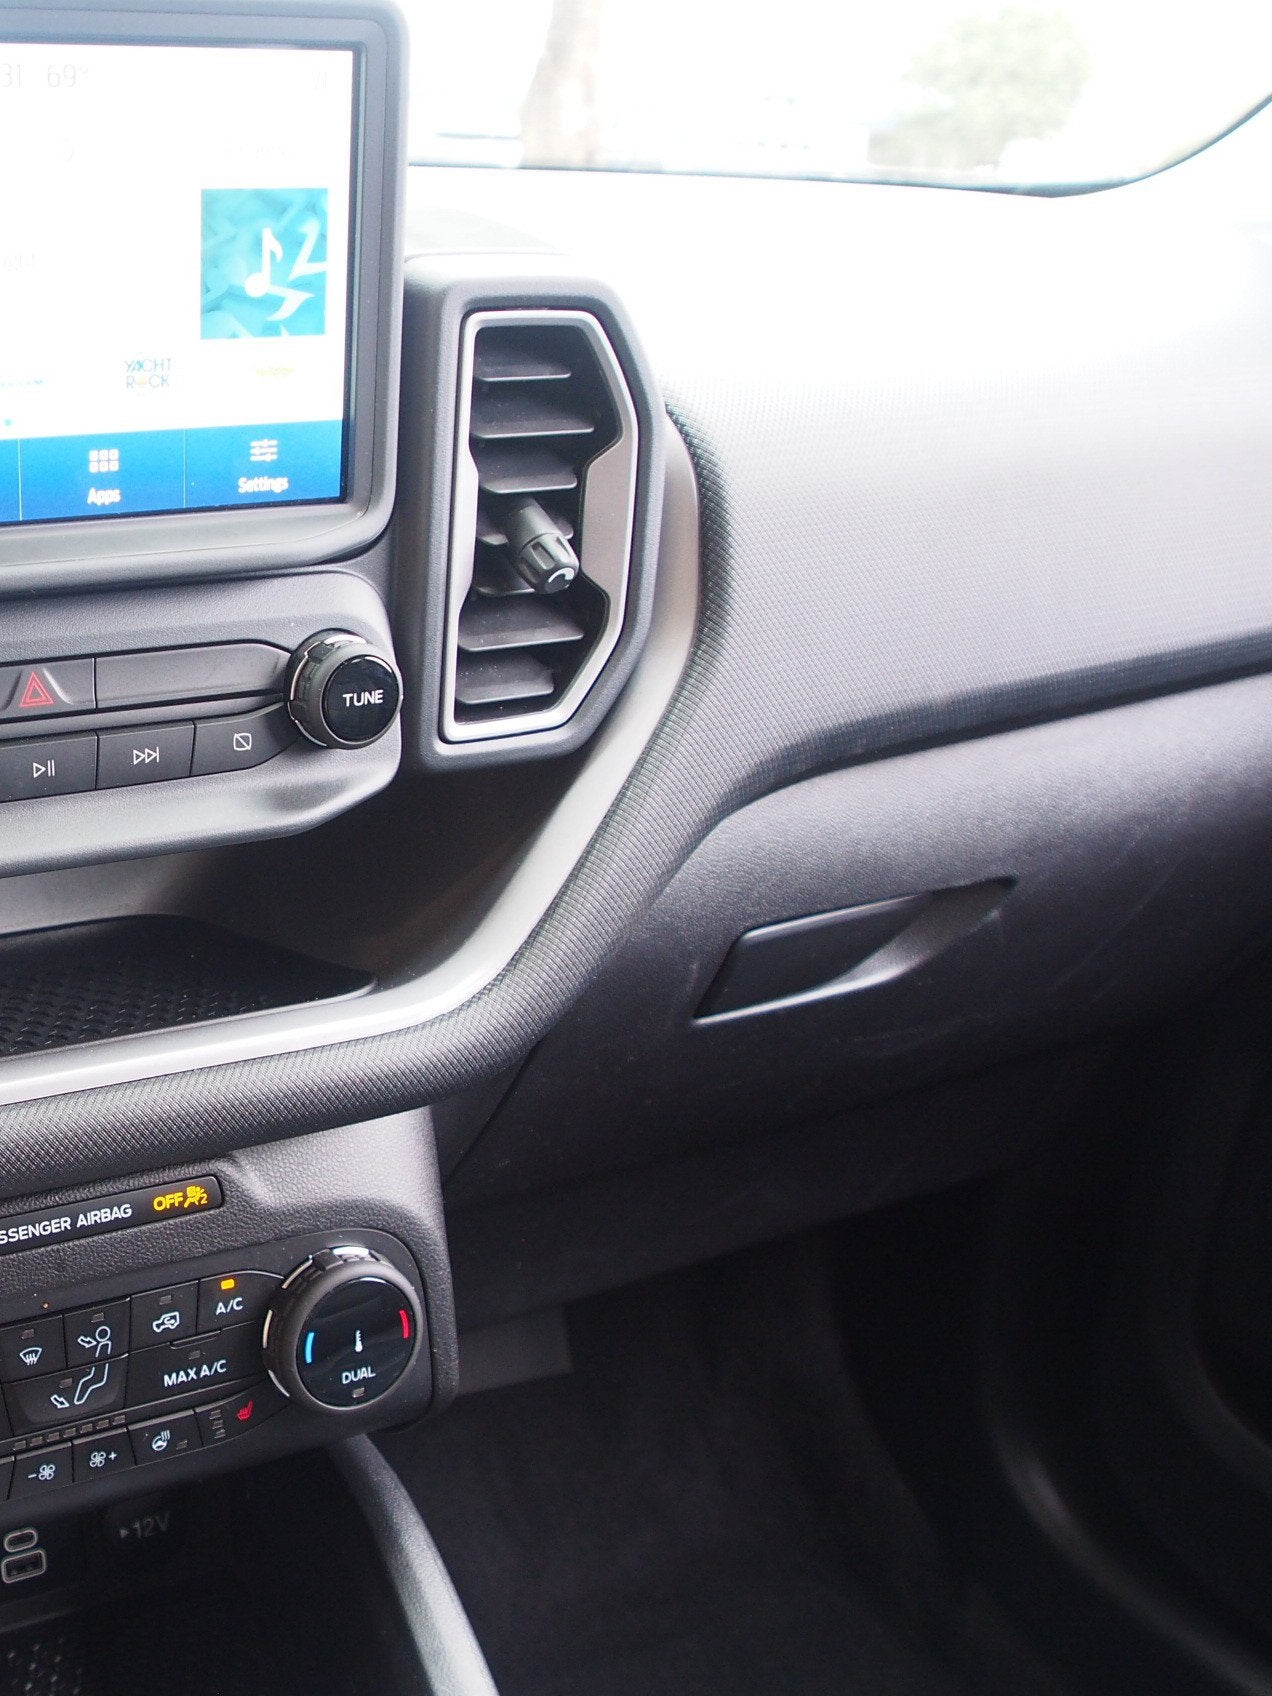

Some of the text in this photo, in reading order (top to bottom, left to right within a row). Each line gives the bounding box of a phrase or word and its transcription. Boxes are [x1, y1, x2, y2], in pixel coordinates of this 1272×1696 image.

[124, 358, 171, 373] YACHT
[237, 475, 289, 494] Settings
[87, 487, 121, 506] Apps
[342, 689, 384, 707] TUNE
[76, 1203, 133, 1228] AIRBAG
[153, 1191, 184, 1211] OFF
[215, 1297, 244, 1315] A/C
[163, 1359, 227, 1387] MAX A/C
[342, 1366, 376, 1384] DUAL
